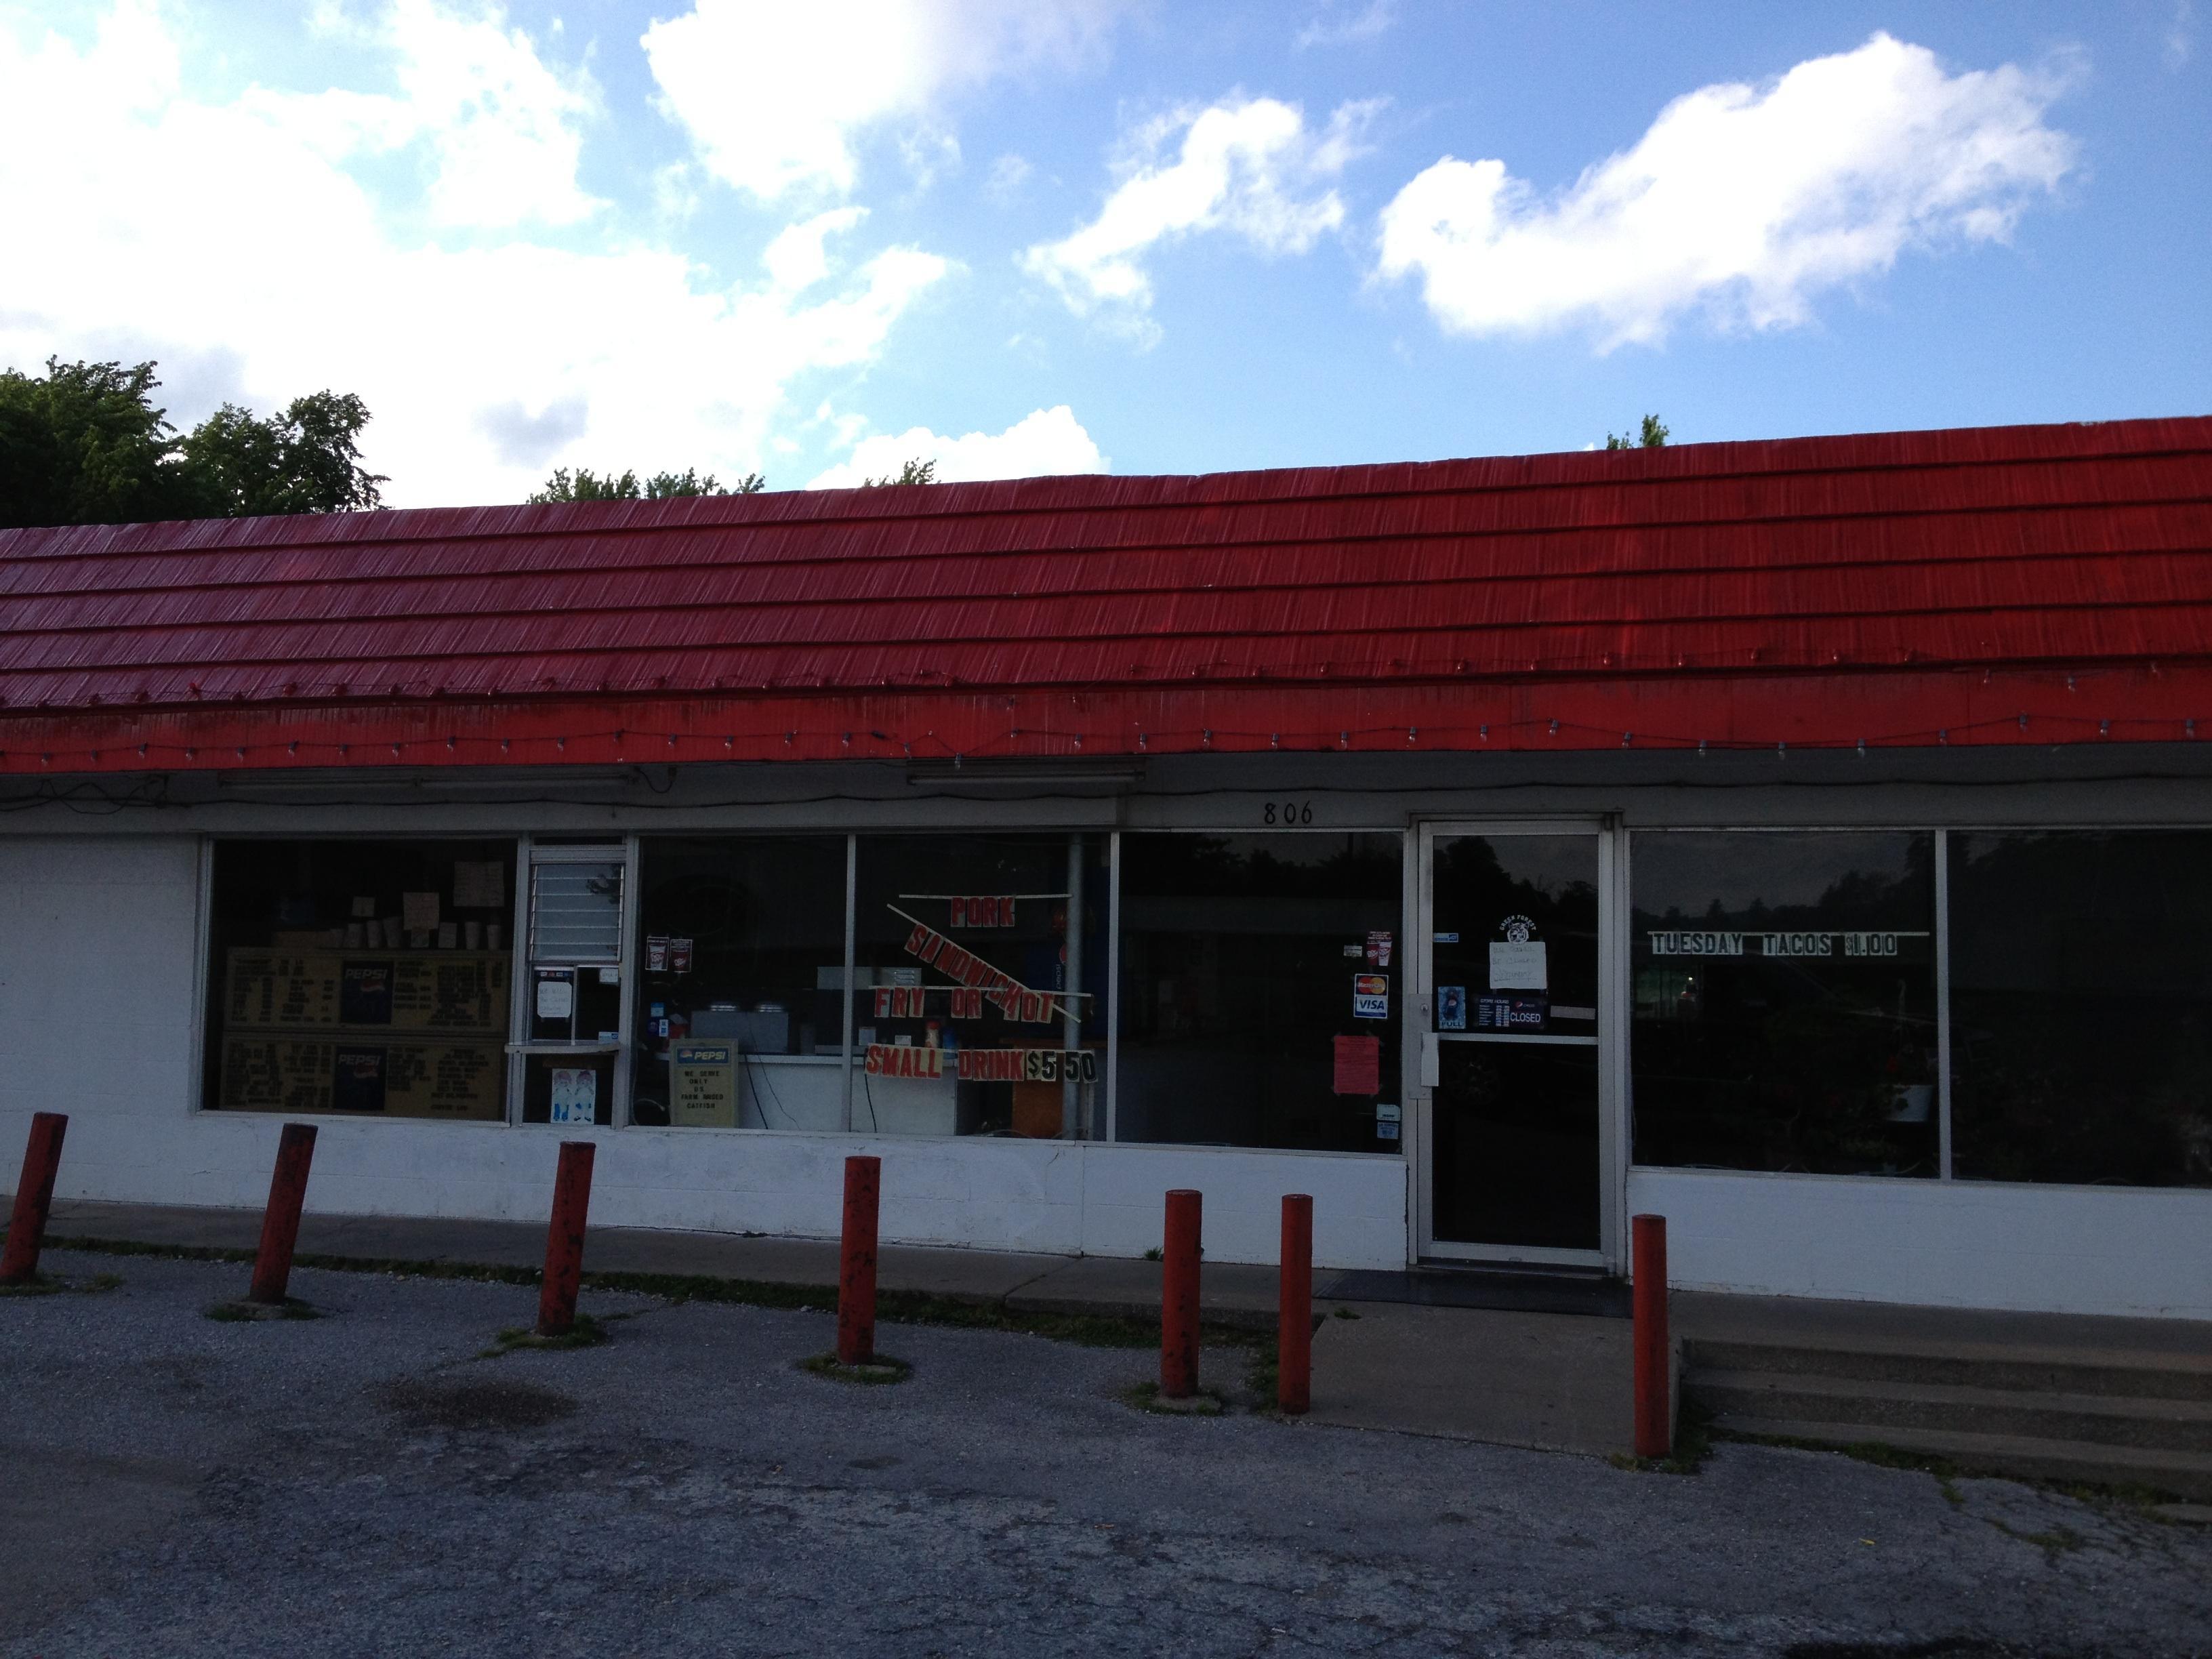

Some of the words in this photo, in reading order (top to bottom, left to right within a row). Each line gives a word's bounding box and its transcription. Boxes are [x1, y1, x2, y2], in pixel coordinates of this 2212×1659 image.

[1265, 800, 1312, 824] 806
[951, 897, 1015, 926] PORK
[1517, 914, 1536, 930] FOREST
[1653, 933, 1743, 954] TUESDAY
[1764, 933, 1831, 954] TACOS
[1845, 934, 1898, 954] $1.00
[346, 968, 388, 980] PEPSI
[907, 924, 1023, 1008] SANDWICH
[875, 987, 925, 1018] FRY
[951, 988, 982, 1019] OR
[1359, 1000, 1385, 1010] VISA
[1510, 1012, 1541, 1023] CLOSED
[338, 1054, 382, 1066] PEPSI
[694, 1051, 726, 1061] PEPSI
[865, 1045, 943, 1079] SMALL
[958, 1050, 1025, 1080] DRINK
